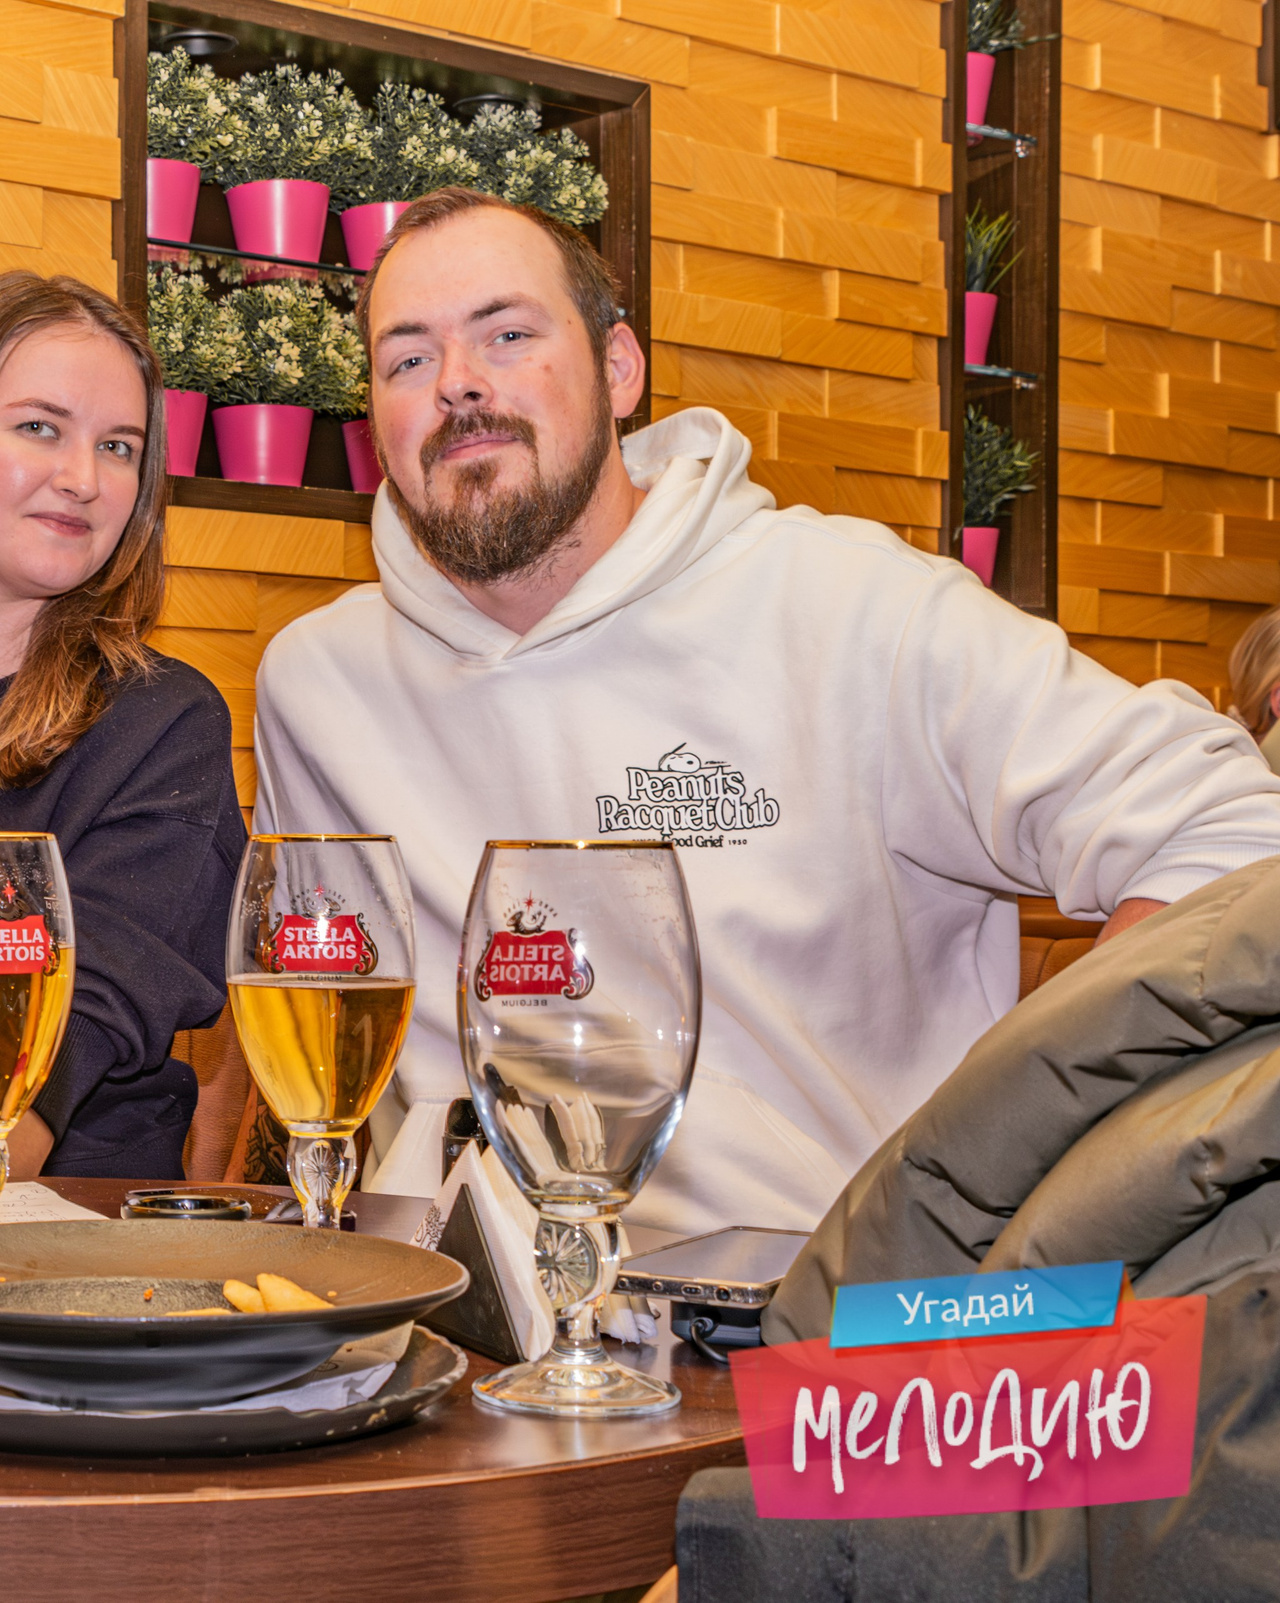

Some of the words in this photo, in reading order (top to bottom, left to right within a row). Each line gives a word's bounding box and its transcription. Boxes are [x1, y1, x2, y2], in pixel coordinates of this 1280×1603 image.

[626, 765, 746, 802] Peanuts
[596, 794, 717, 836] Racquet
[714, 788, 780, 831] Club
[695, 835, 724, 848] Grief
[283, 926, 357, 942] STELLA
[282, 944, 357, 960] ARTOIS
[297, 974, 342, 982] BELGIUM
